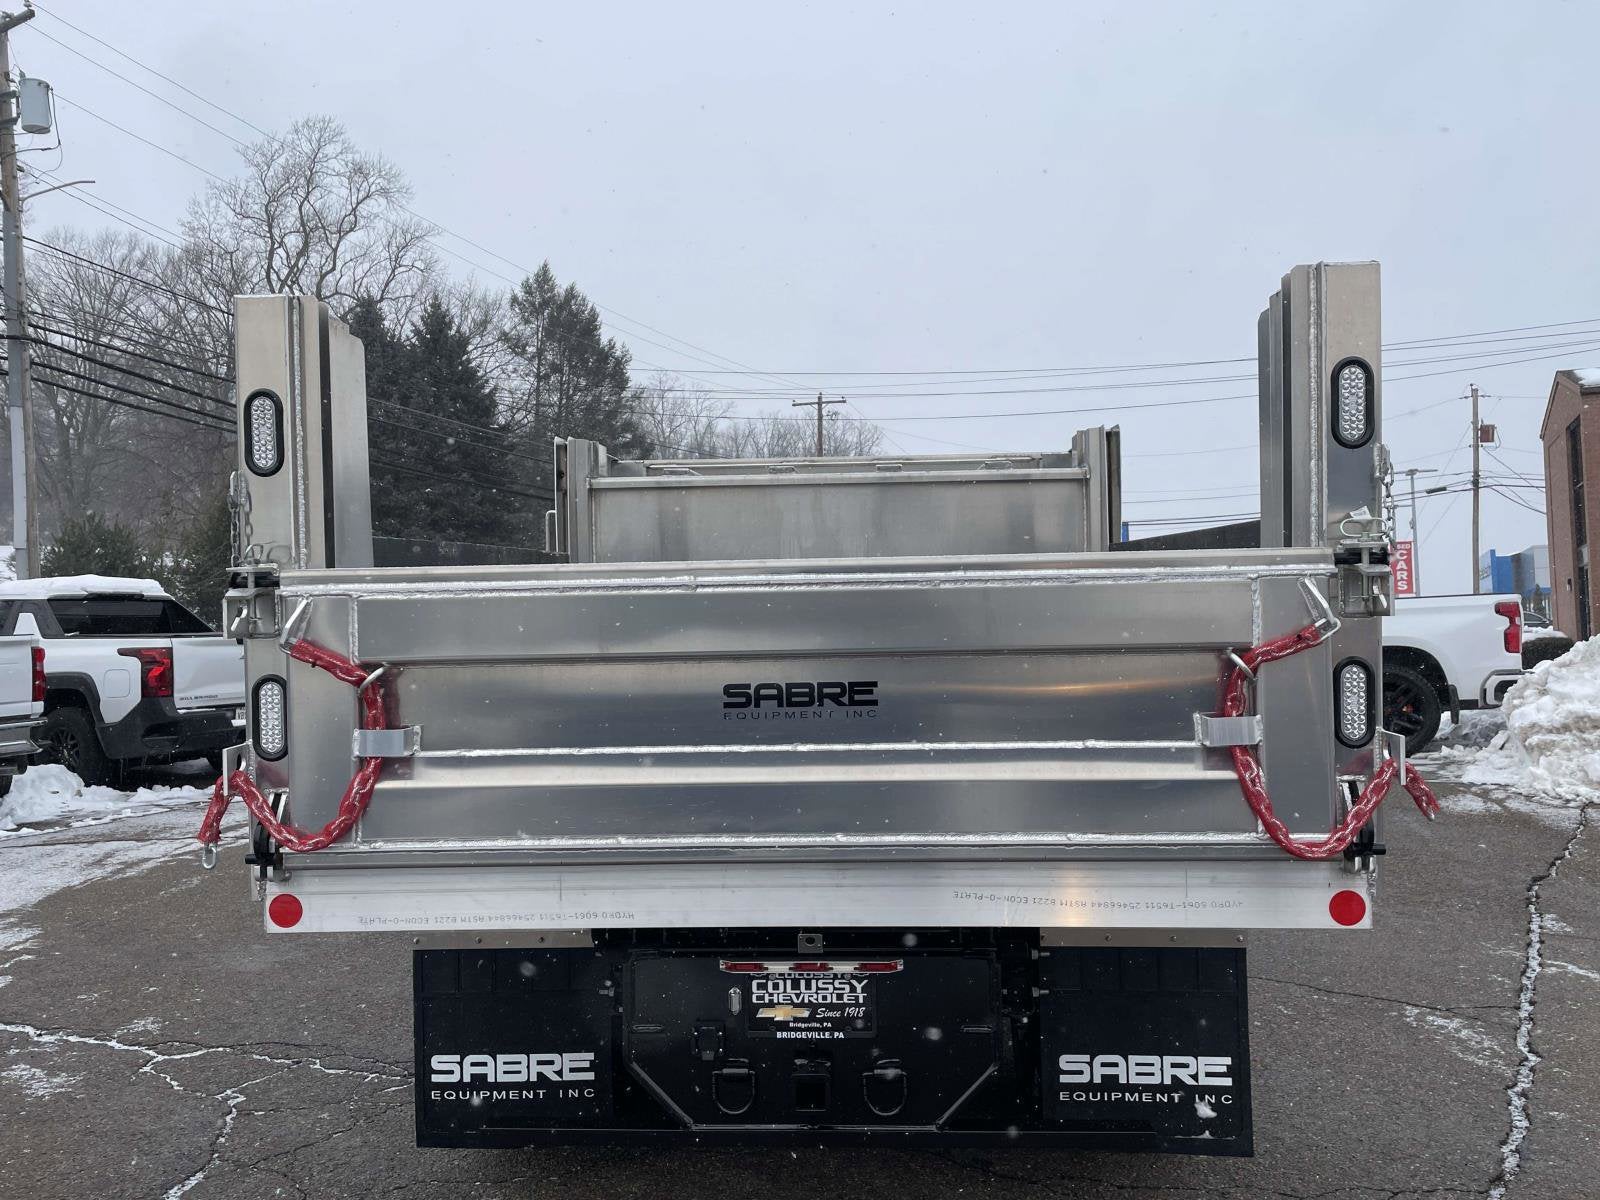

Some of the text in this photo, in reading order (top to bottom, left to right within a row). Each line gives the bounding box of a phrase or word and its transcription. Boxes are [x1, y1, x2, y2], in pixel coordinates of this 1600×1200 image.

[1396, 550, 1408, 591] CARS
[723, 681, 878, 709] SABRE
[723, 709, 877, 720] EQUIPMENT INC
[752, 979, 869, 994] COLUSSY
[752, 993, 867, 1004] CHEVROLET
[815, 1007, 866, 1018] Since 1918
[834, 1031, 845, 1039] PA
[430, 1052, 595, 1083] SABRE
[1059, 1054, 1233, 1086] SABRE
[431, 1088, 595, 1100] EQUIPMENT INC
[1059, 1091, 1233, 1104] EQUIPMENT INC
